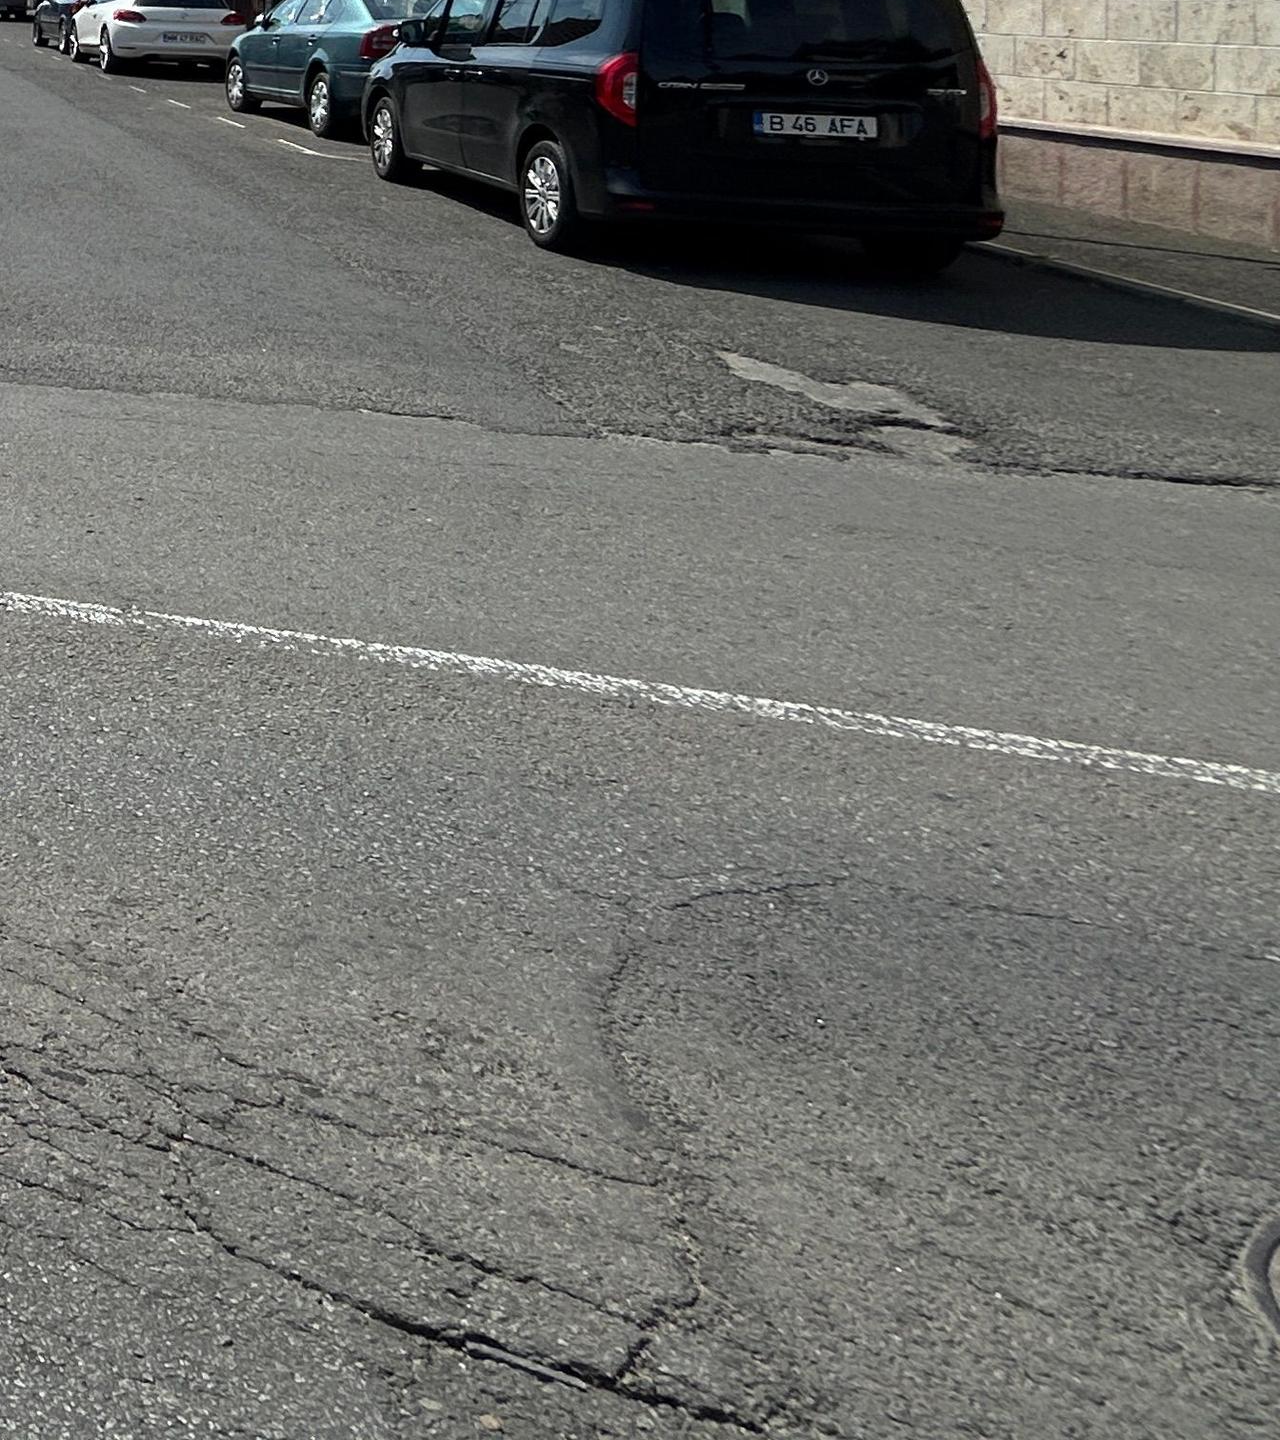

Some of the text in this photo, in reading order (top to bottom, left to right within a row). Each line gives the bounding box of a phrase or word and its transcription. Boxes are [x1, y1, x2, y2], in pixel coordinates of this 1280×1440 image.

[769, 115, 785, 132] B
[791, 116, 817, 133] 46
[827, 118, 868, 136] AFA
